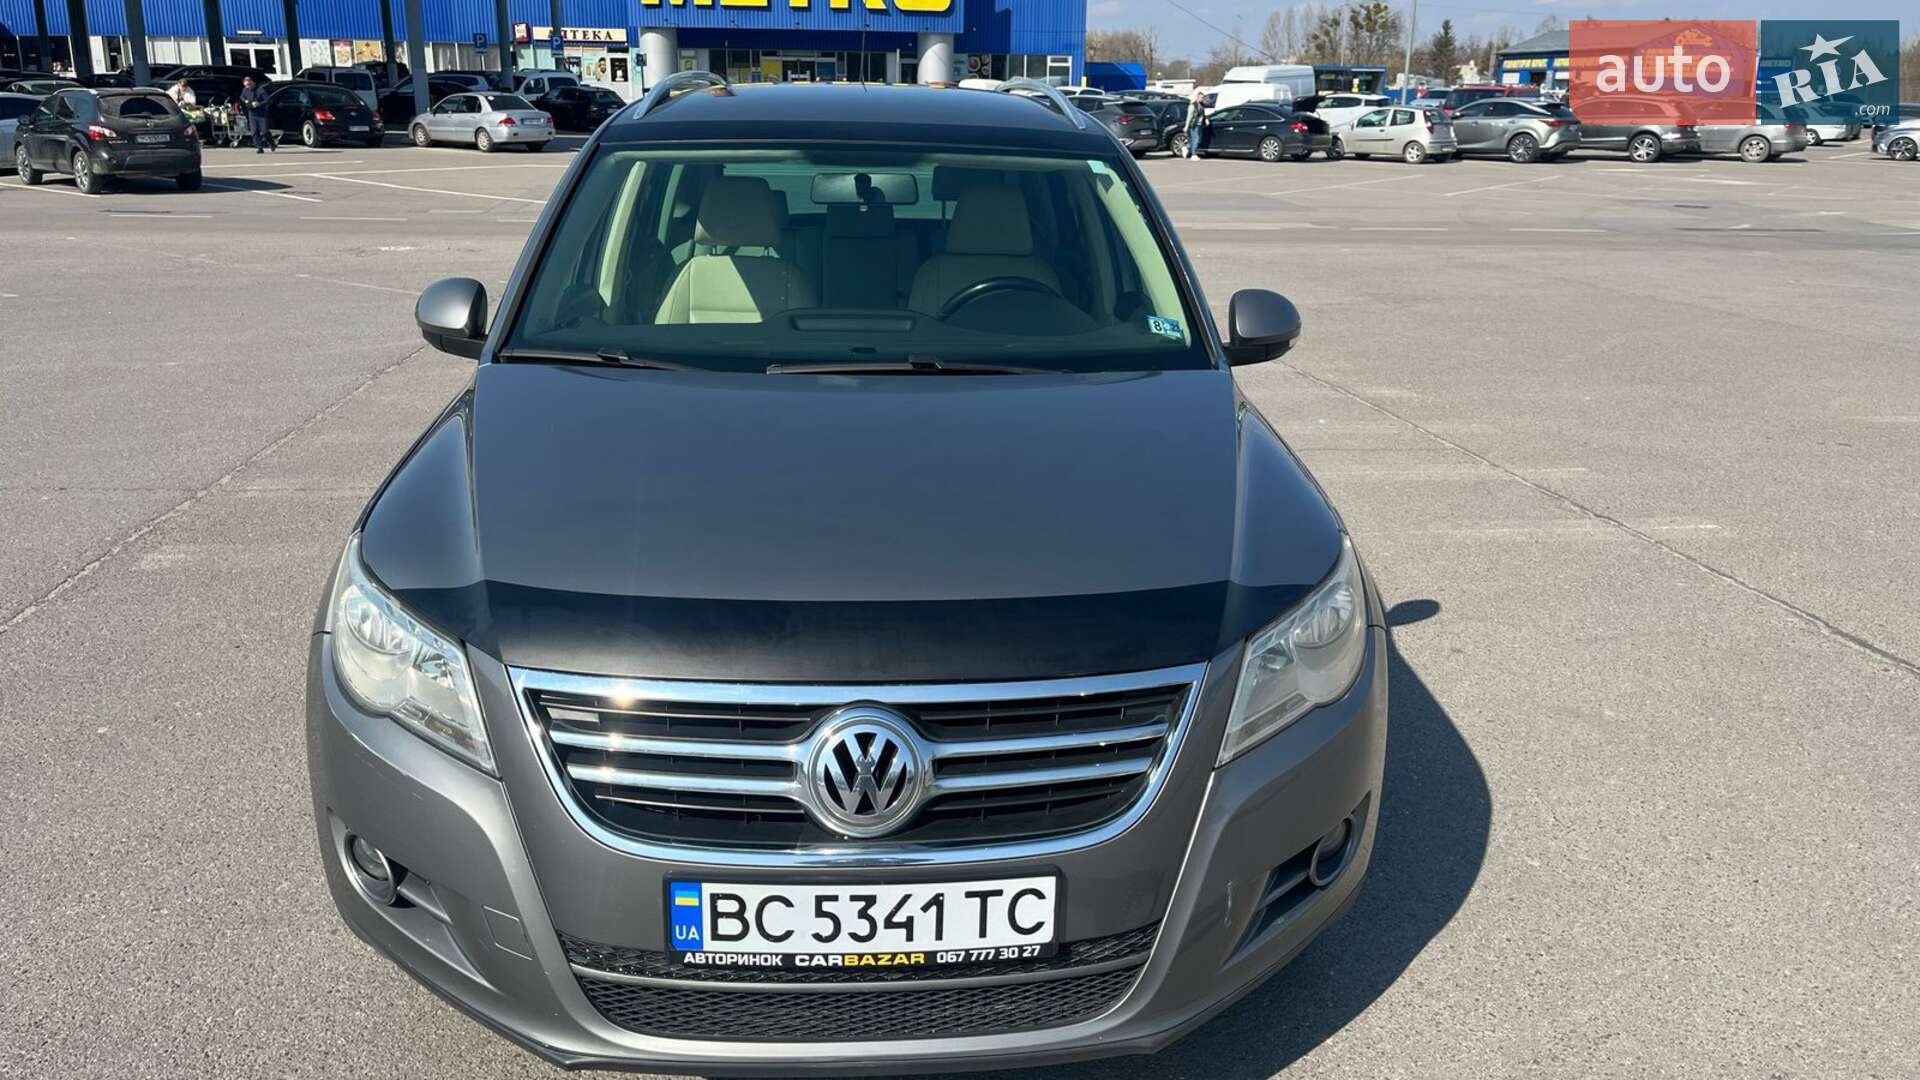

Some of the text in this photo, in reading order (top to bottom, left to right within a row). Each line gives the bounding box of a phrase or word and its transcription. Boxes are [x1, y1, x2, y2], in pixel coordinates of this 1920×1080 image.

[1153, 319, 1162, 332] 8
[709, 887, 1046, 943] BC 5341 TC
[674, 925, 700, 940] UA
[683, 945, 1041, 967] АВТОРИНОК CARBAZAR 067 777 30 27
